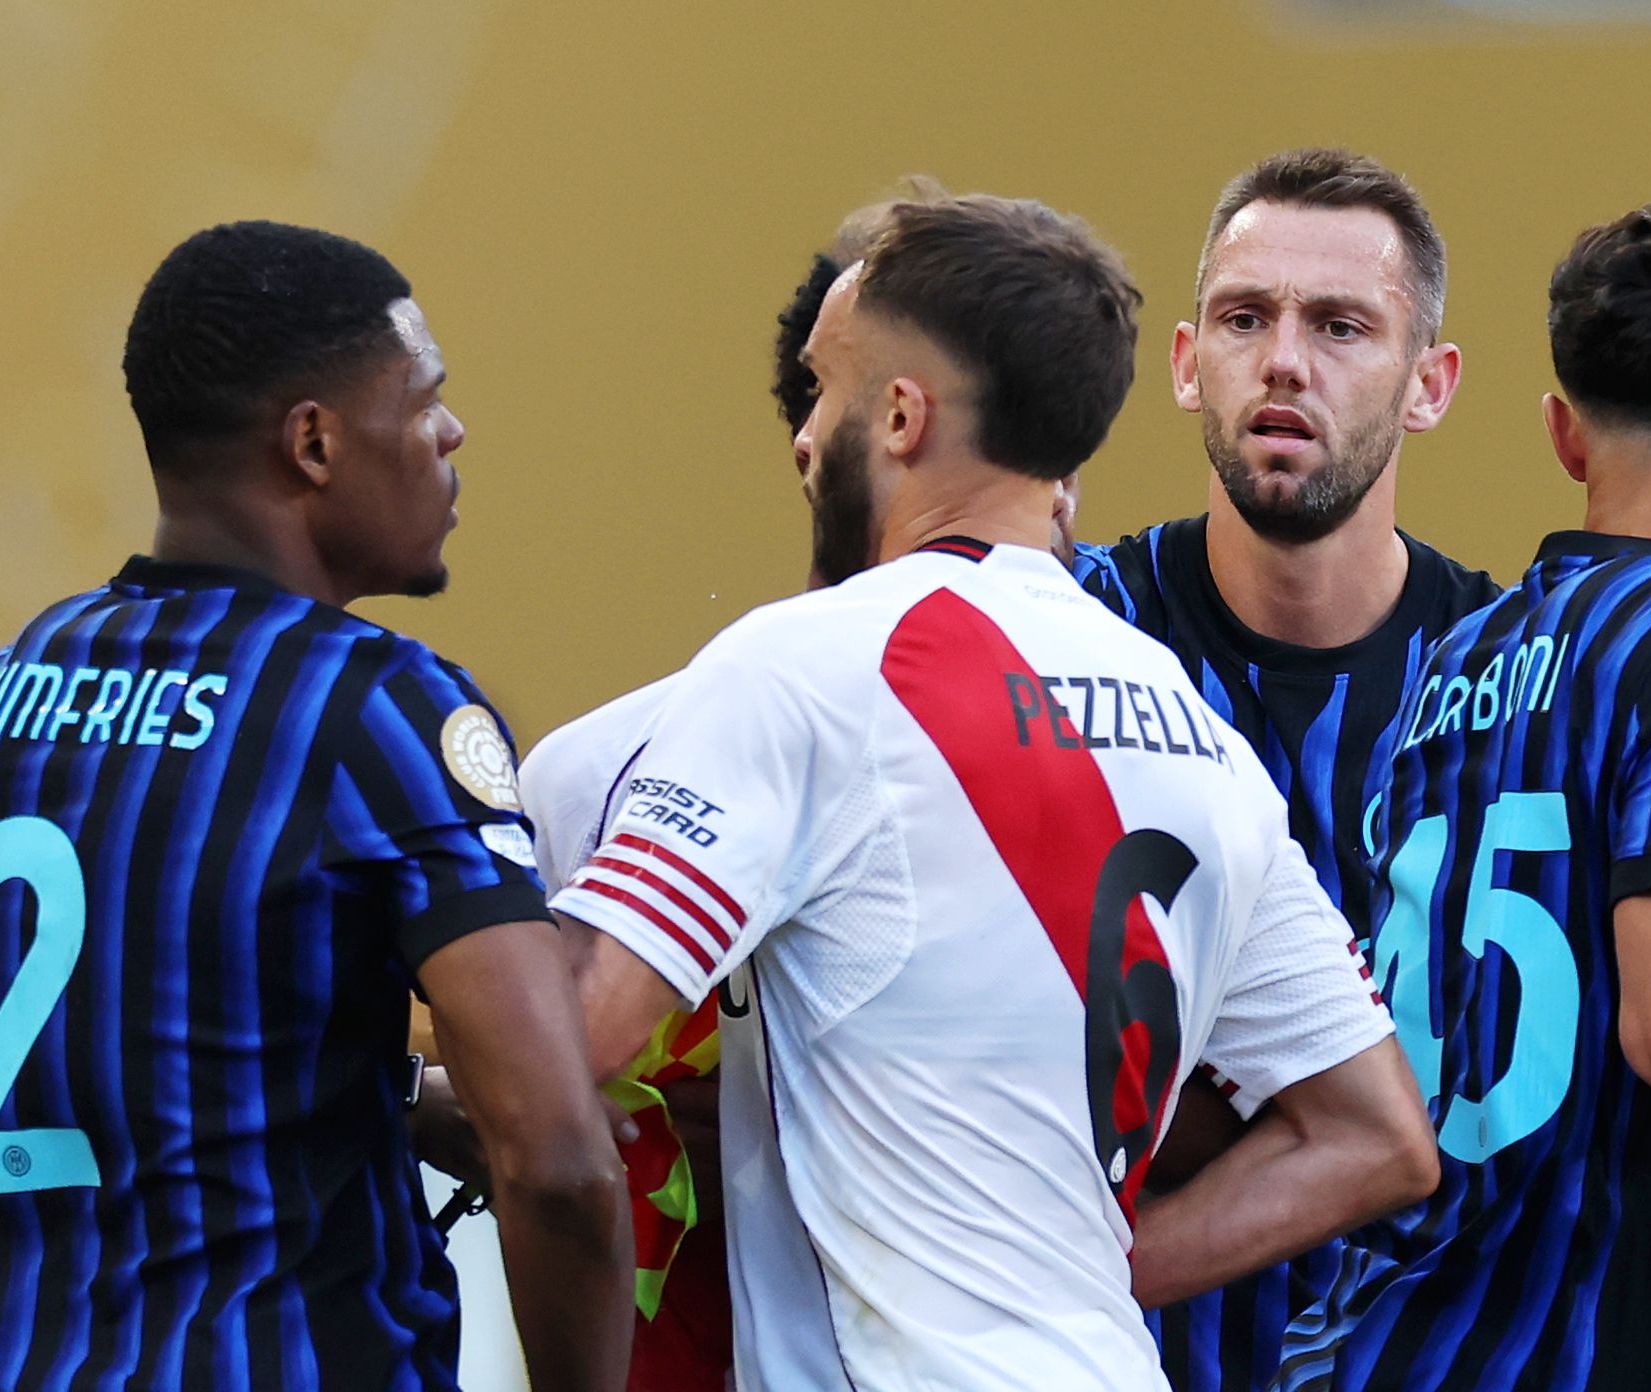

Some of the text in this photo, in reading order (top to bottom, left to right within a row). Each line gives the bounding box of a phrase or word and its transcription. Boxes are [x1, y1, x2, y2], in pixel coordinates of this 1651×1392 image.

[1003, 671, 1236, 777] PEZZELLA
[628, 801, 719, 848] CARD
[630, 778, 726, 818] ASSIST
[1085, 828, 1200, 1197] 6
[1374, 791, 1580, 1164] 45
